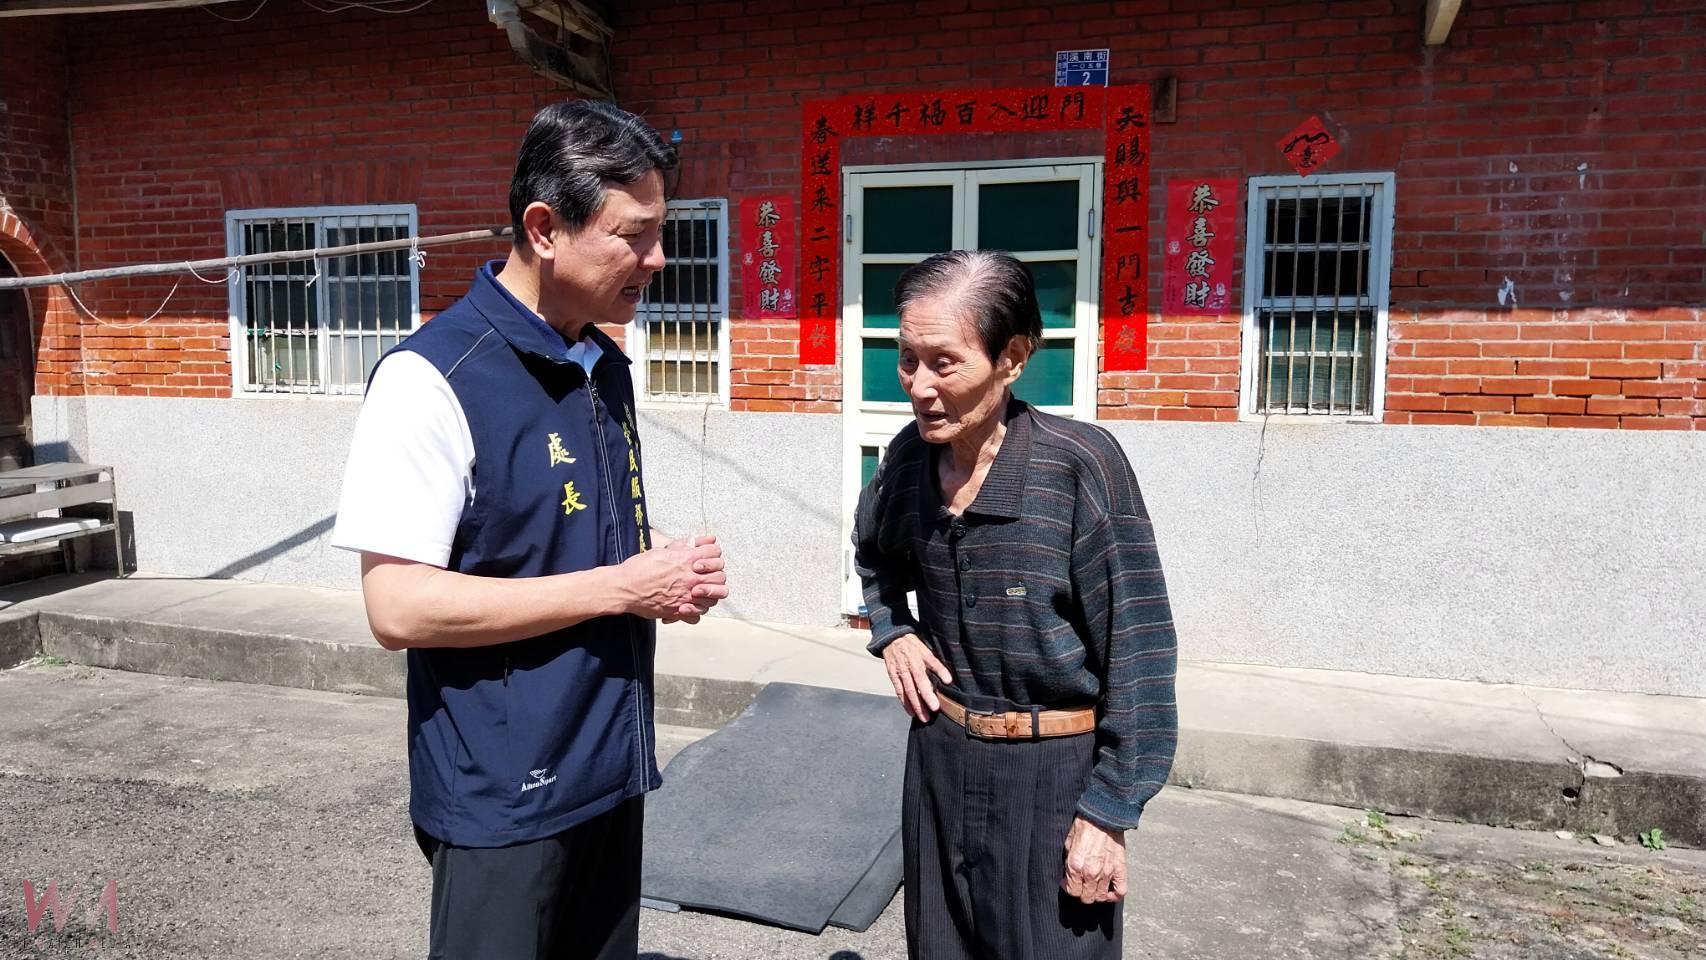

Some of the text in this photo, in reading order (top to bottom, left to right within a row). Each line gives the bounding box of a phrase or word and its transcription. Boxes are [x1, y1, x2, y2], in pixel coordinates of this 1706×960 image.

[1082, 71, 1091, 86] 2
[757, 201, 781, 311] 恭喜發財
[1184, 184, 1219, 308] 恭喜發財
[548, 432, 588, 516] 處長
